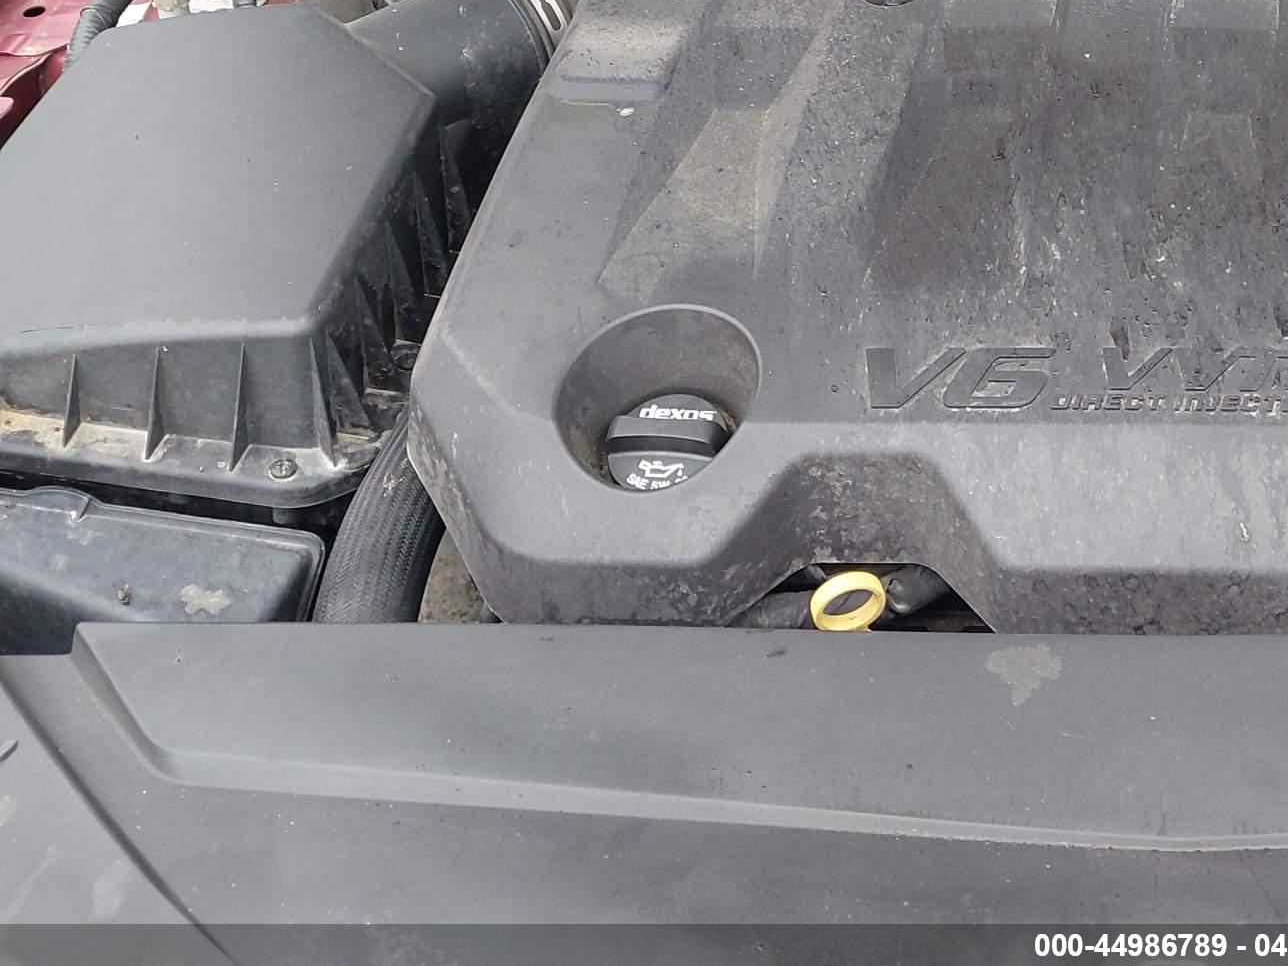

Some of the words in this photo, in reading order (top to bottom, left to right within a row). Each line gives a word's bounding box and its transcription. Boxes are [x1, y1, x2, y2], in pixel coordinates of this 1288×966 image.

[865, 347, 1056, 409] V6
[1050, 393, 1166, 411] DIRECT
[638, 404, 715, 422] dexos
[626, 473, 649, 490] SAE
